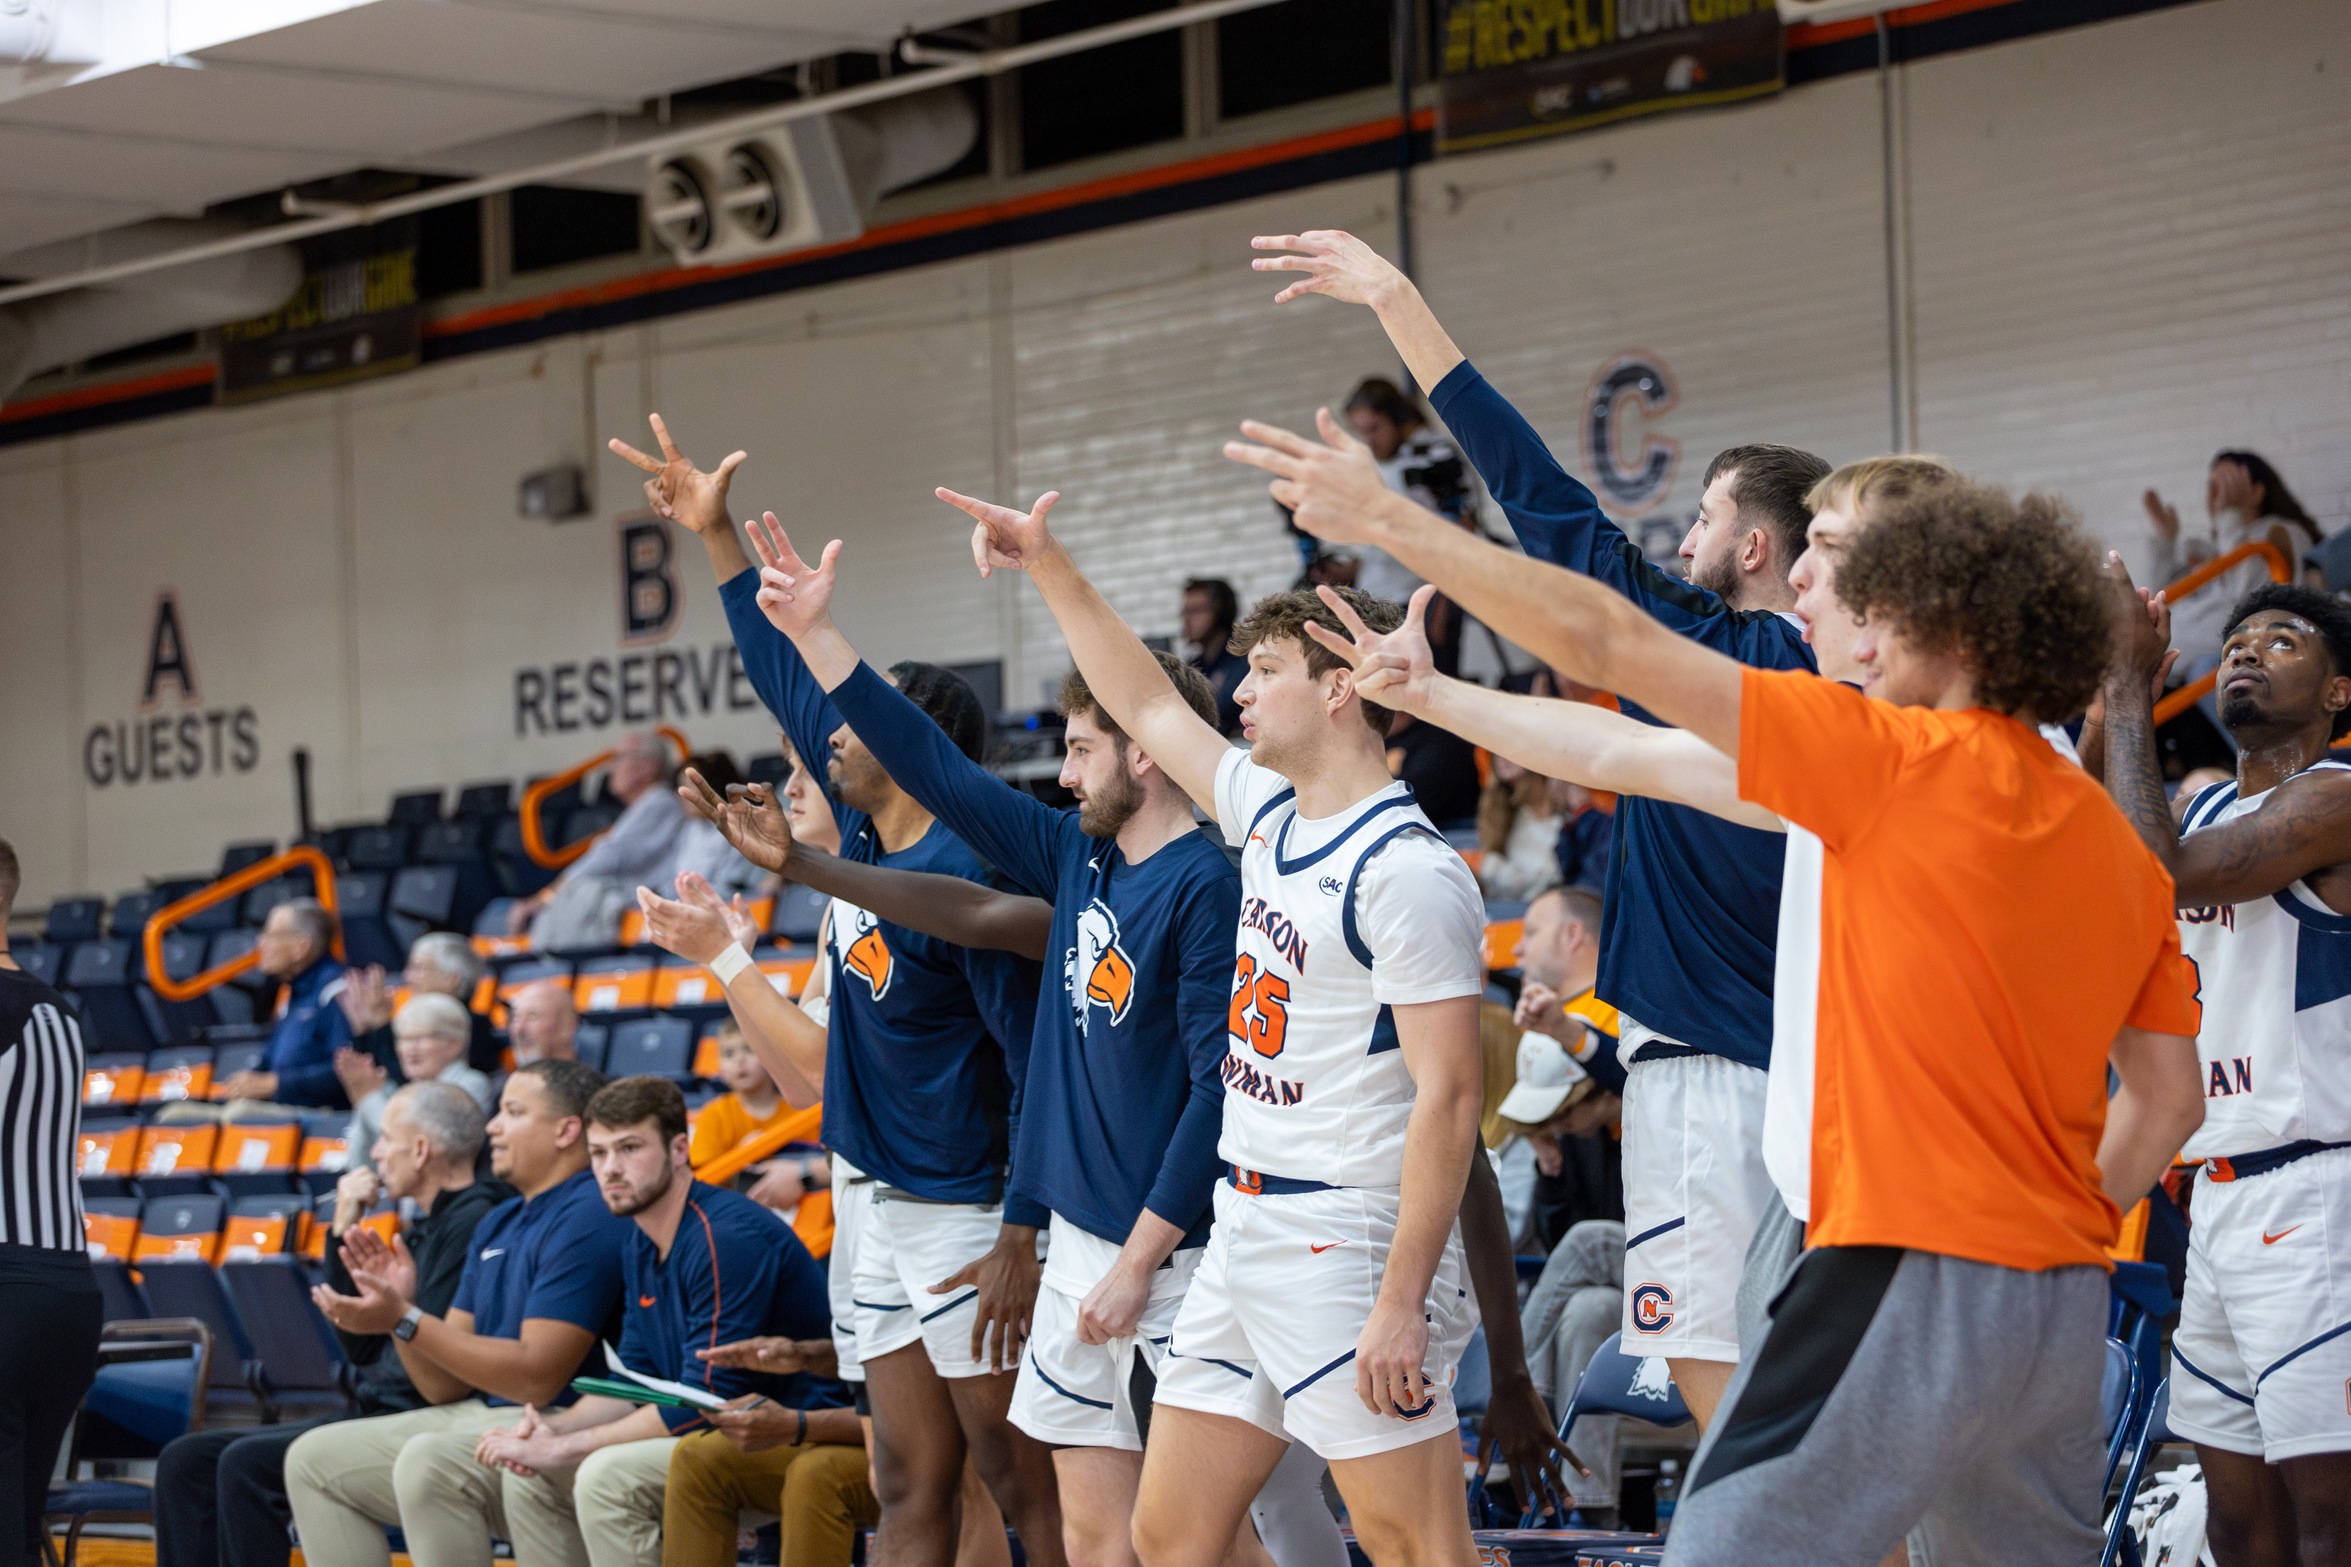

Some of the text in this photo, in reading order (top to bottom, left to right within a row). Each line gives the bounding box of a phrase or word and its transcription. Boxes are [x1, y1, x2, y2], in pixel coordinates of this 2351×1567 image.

[1581, 351, 1681, 515] C
[615, 513, 686, 647] B
[140, 590, 202, 711] A
[83, 704, 261, 789] GUESTS
[1320, 875, 1343, 895] SAC
[1228, 951, 1292, 1060] 25
